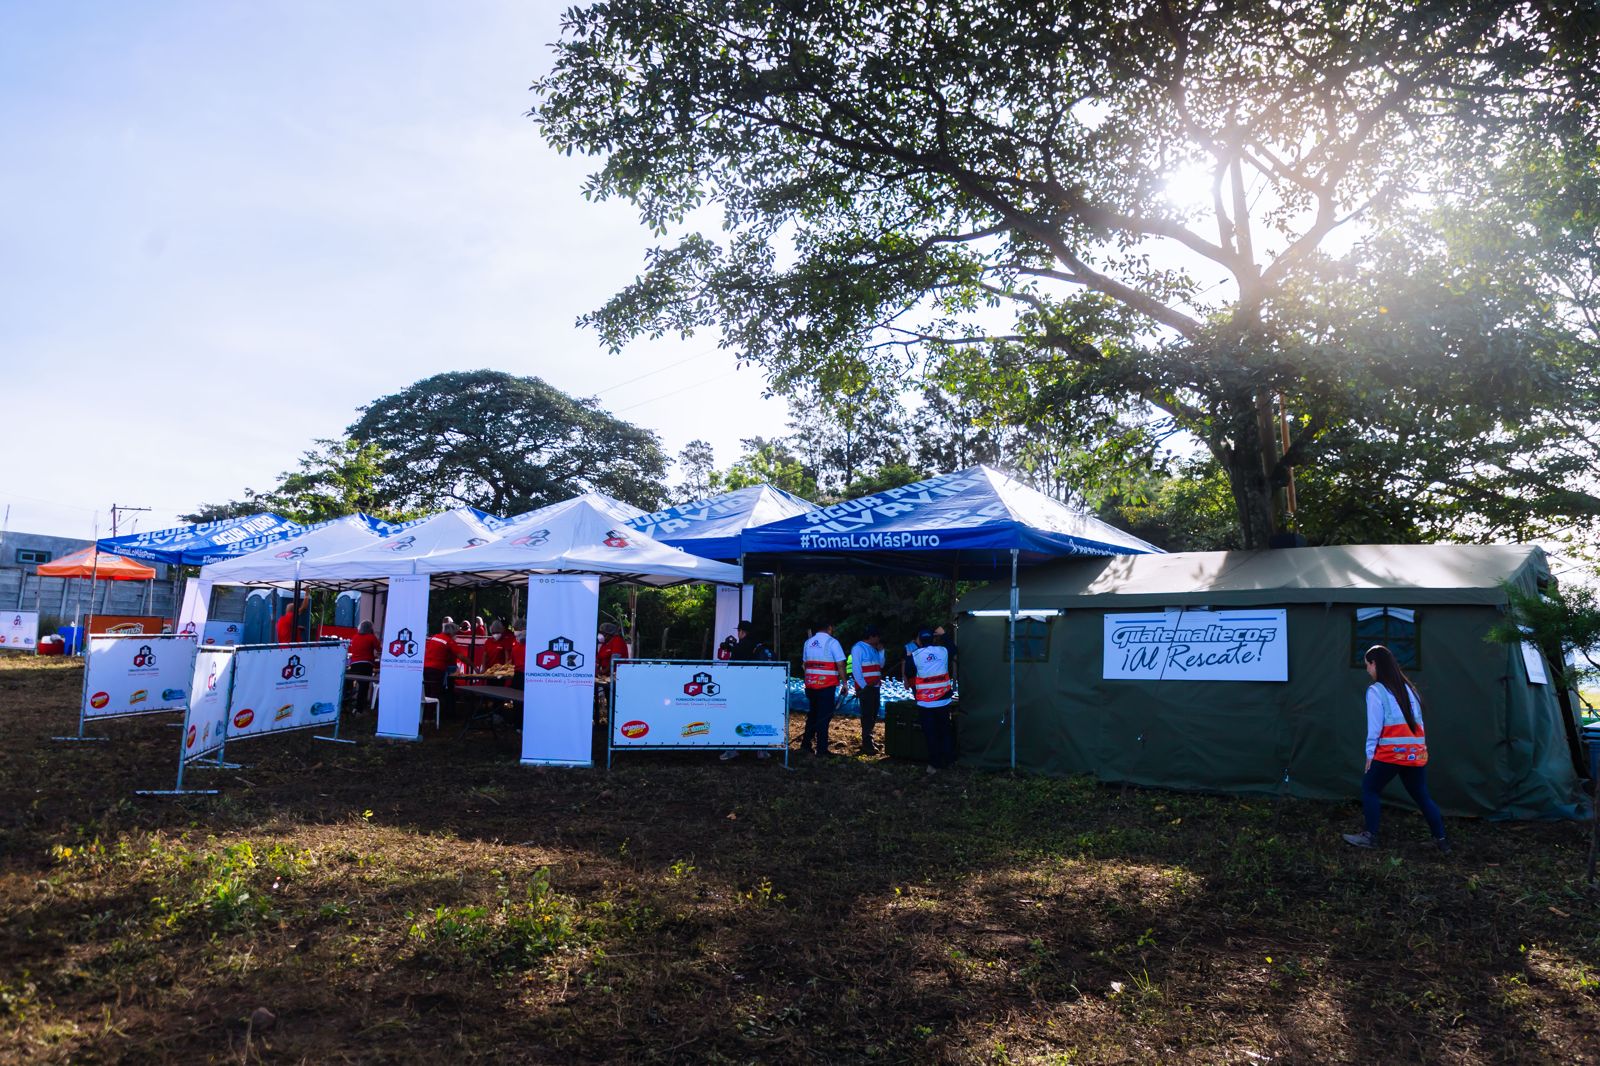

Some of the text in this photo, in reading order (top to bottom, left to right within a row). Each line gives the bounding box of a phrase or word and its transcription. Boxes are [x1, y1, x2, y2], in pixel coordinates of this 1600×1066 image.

[805, 496, 883, 524] AGUA
[137, 525, 191, 541] AGUA
[226, 533, 282, 551] AGUA
[800, 532, 940, 549] #TomaLoMásPuro
[1112, 624, 1277, 649] Guatemaltecos
[1122, 639, 1267, 672] ¡Al Rescate!
